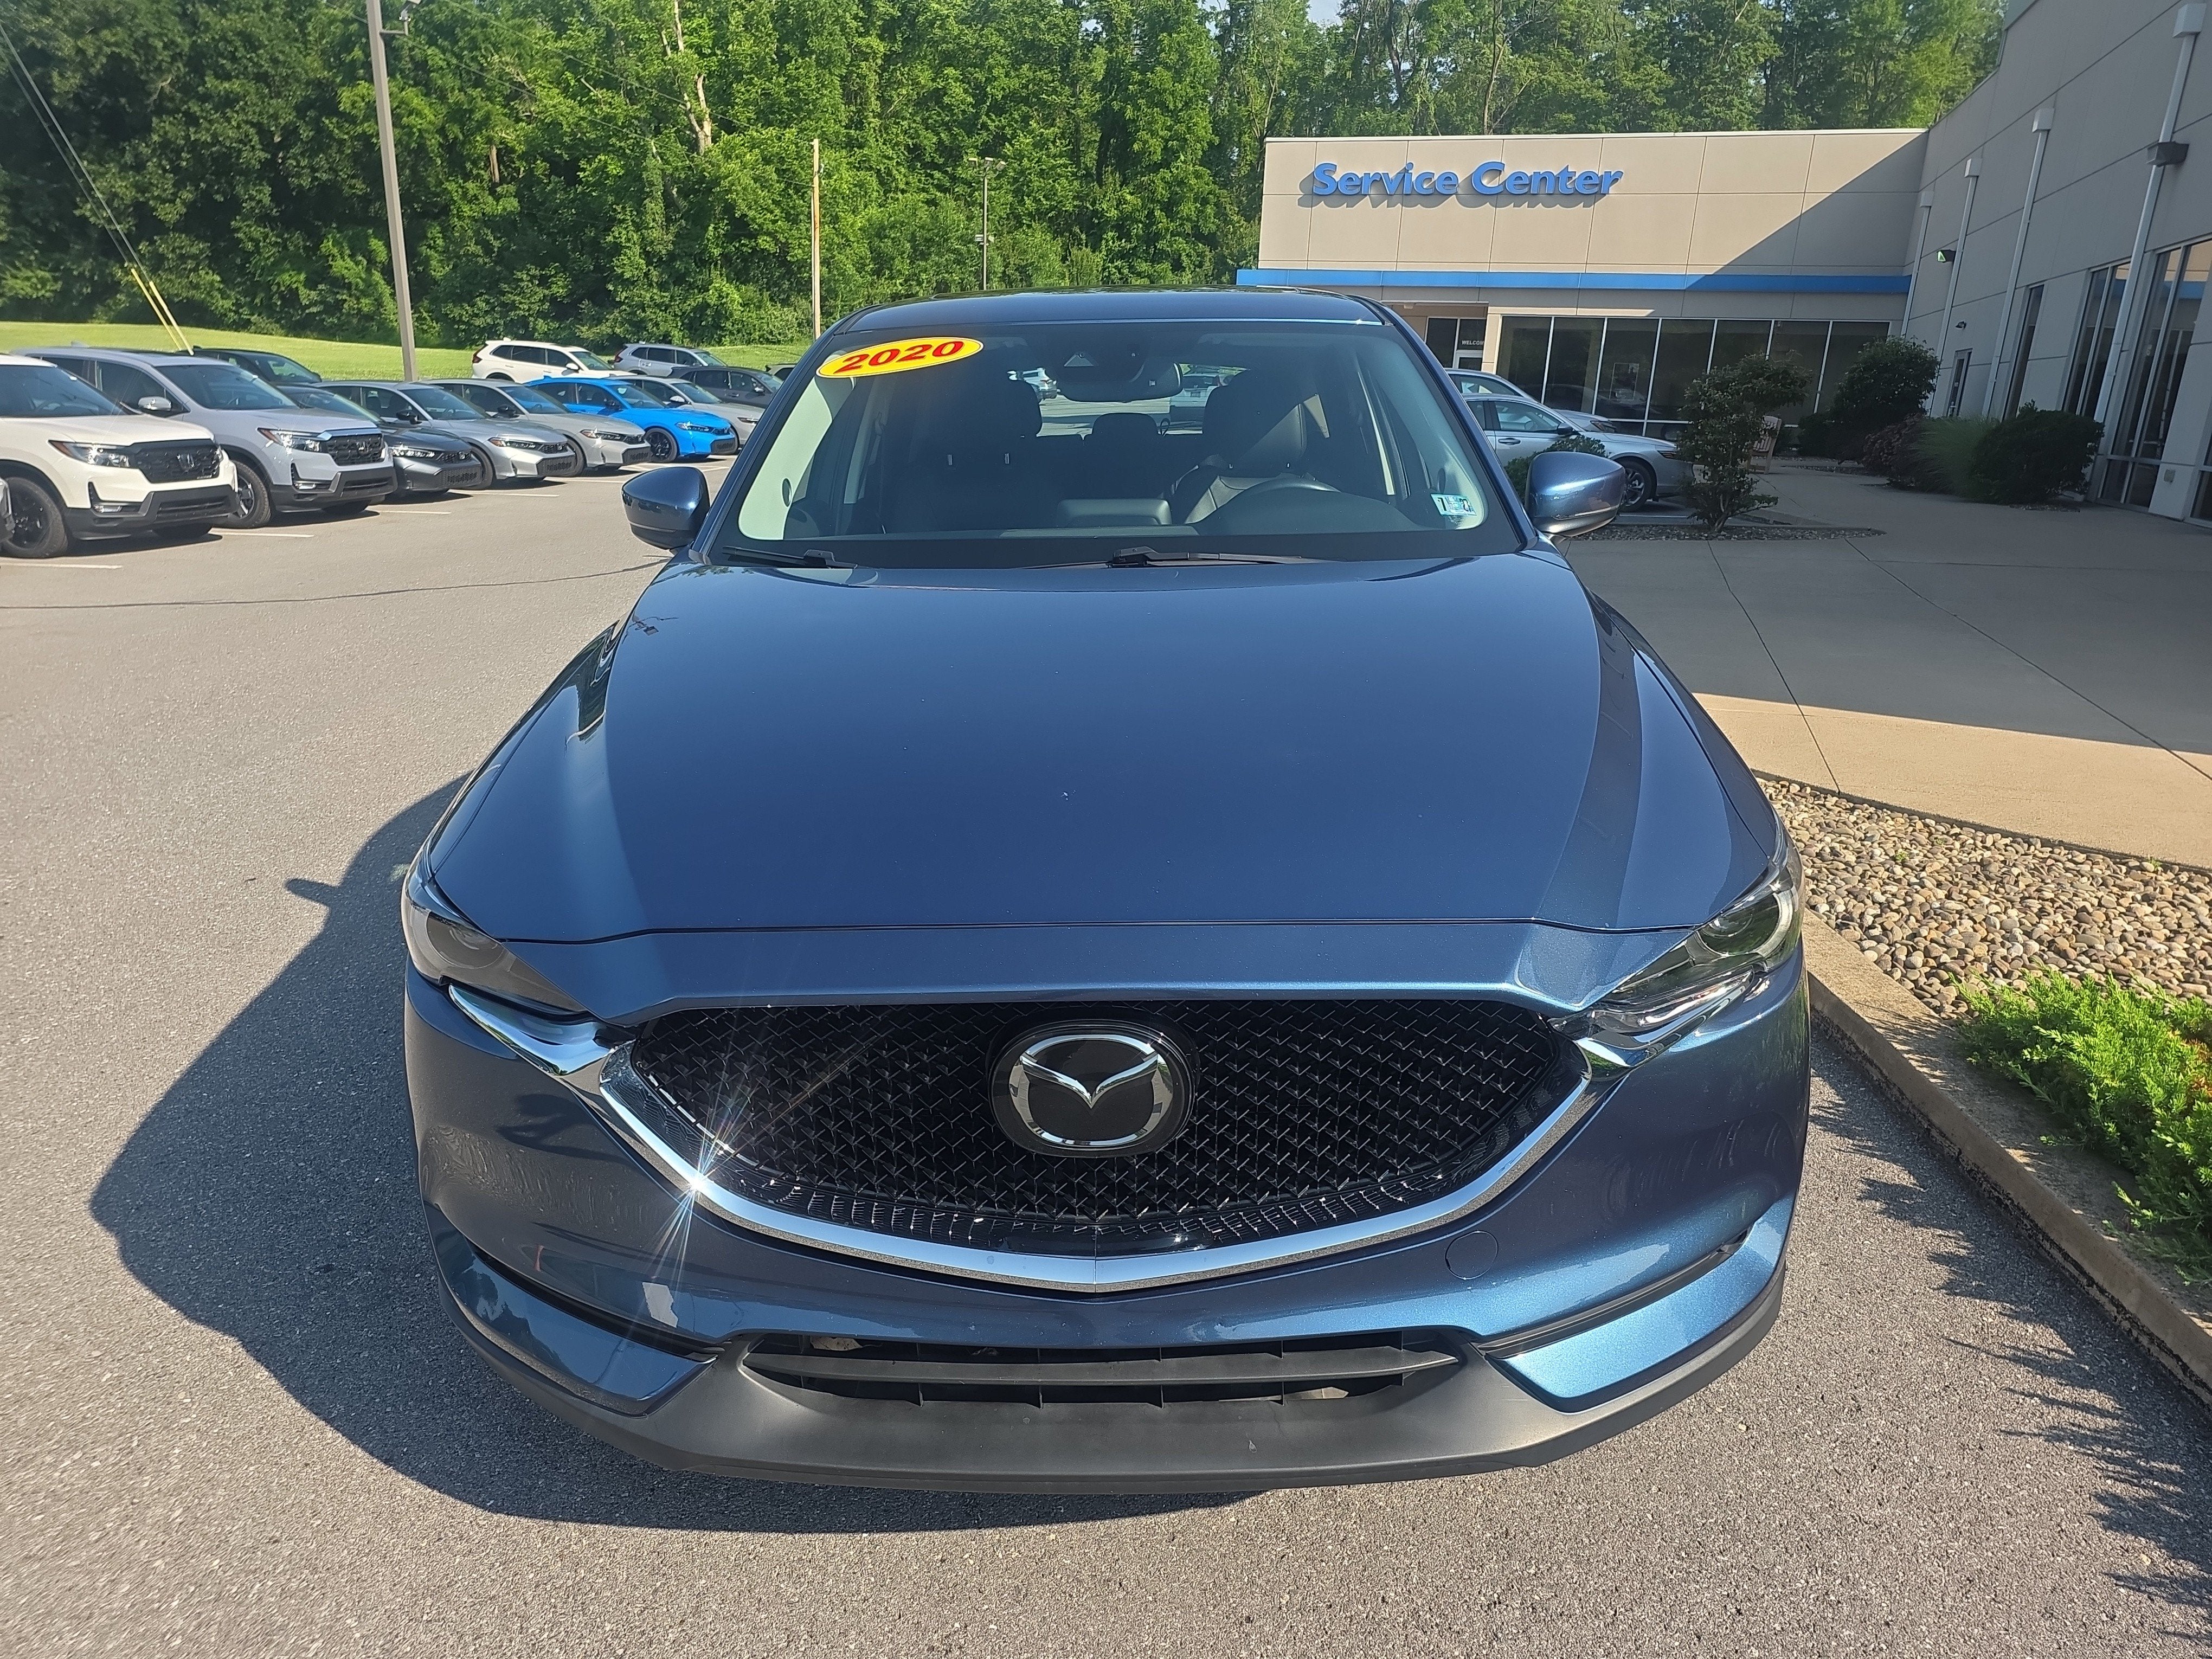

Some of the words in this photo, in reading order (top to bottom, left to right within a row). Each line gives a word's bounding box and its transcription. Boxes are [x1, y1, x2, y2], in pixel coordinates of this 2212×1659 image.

[1314, 162, 1459, 195] Service
[1471, 162, 1623, 194] Center
[833, 341, 964, 374] 2020
